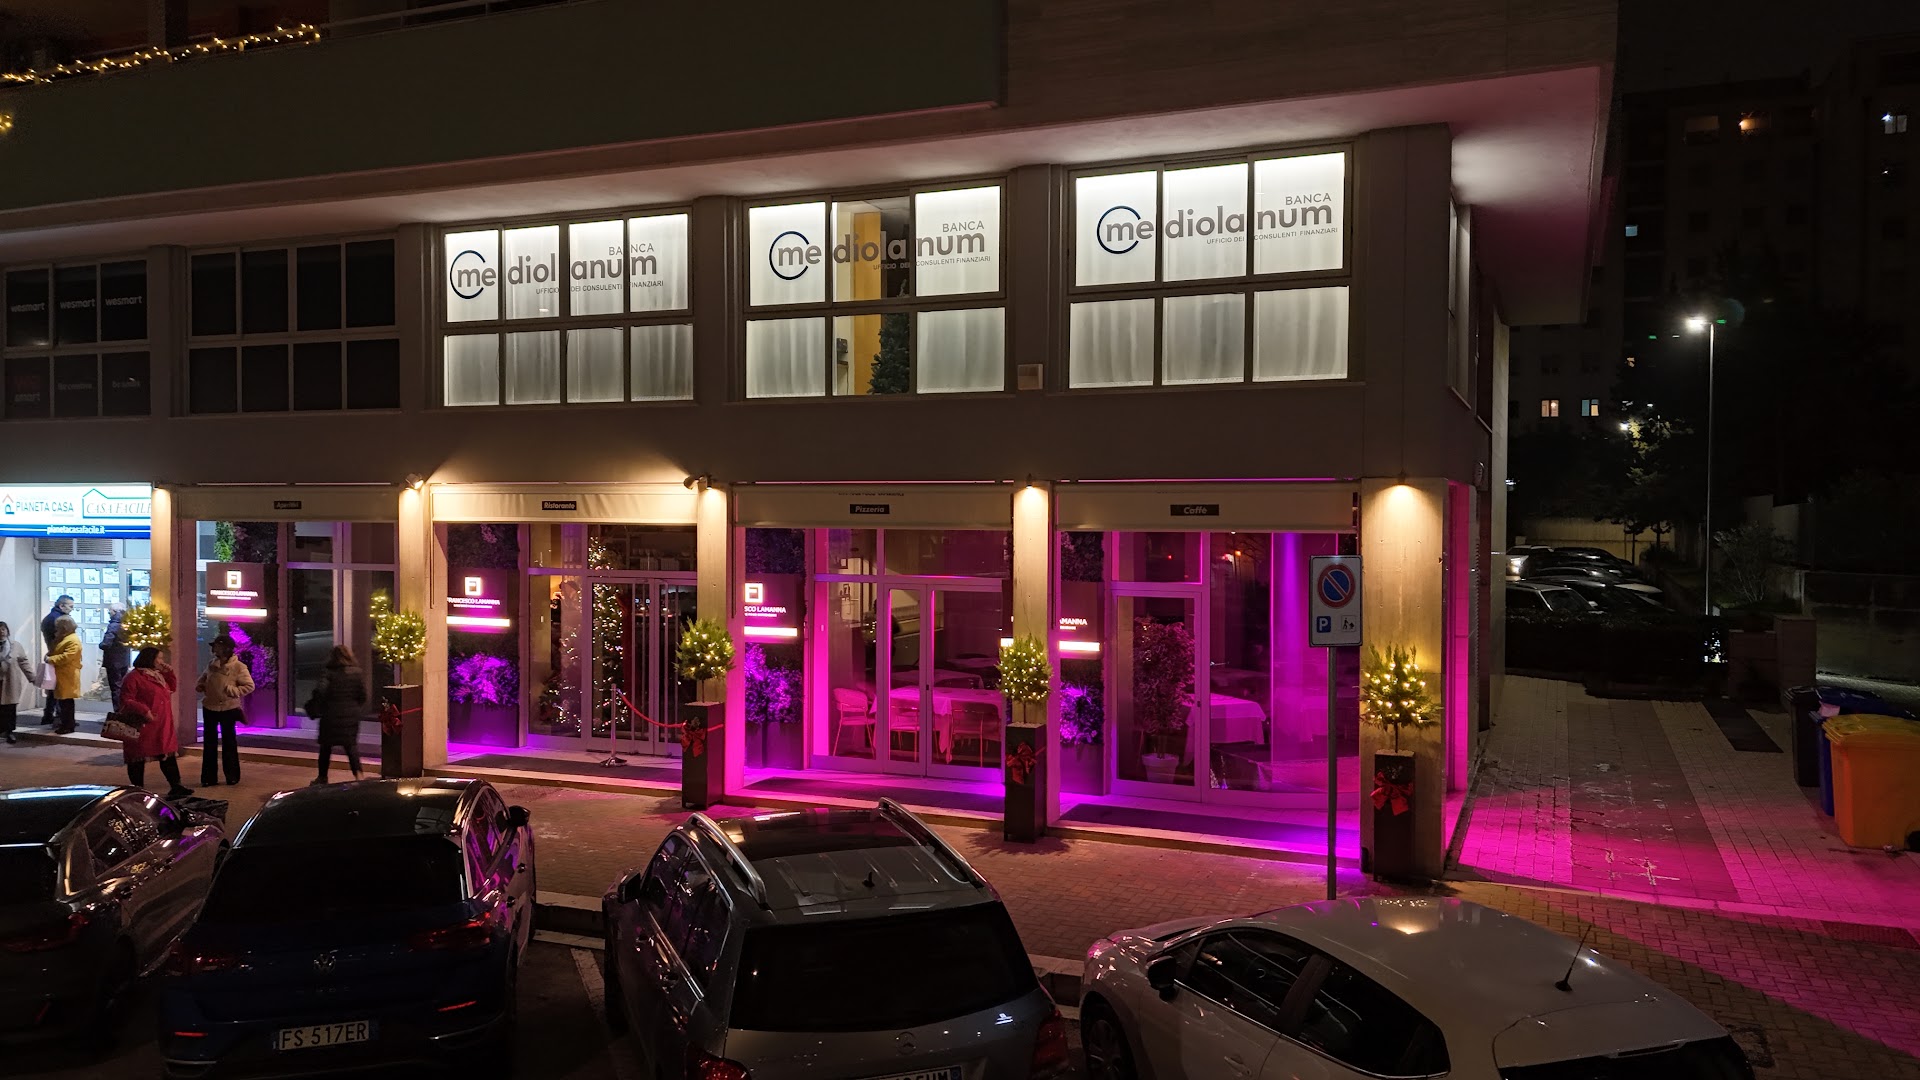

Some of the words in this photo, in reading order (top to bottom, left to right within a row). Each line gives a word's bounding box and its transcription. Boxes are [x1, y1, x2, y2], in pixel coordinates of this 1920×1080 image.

[1285, 192, 1332, 206] BANCA
[942, 220, 985, 233] BANCA
[1206, 236, 1232, 245] UFFICIO
[1254, 231, 1297, 241] CONSULENTI
[1299, 227, 1338, 236] FINANZIARI
[608, 243, 655, 256] BANCA
[873, 262, 897, 270] UFFICIO
[916, 258, 955, 267] CONSULENTI
[956, 255, 991, 264] FINANZIARI
[536, 286, 560, 295] UFFICIO
[570, 285, 581, 293] DEI
[582, 283, 623, 292] CONSULENTI
[60, 298, 96, 309] wesmart
[105, 295, 143, 307] wesmart
[10, 302, 46, 313] wesmart
[16, 501, 50, 512] PIANETA
[51, 501, 74, 513] CASA
[86, 502, 114, 514] CASA
[543, 501, 576, 510] Ristorante
[855, 505, 885, 513] Pizzeria
[1183, 505, 1208, 515] Caffè
[46, 525, 105, 535] pianetacasafacile.it
[756, 606, 787, 614] LAMANNA
[1059, 617, 1088, 626] MANNA
[1319, 617, 1329, 631] P
[281, 1029, 304, 1049] FS
[311, 1022, 367, 1045] 517ER
